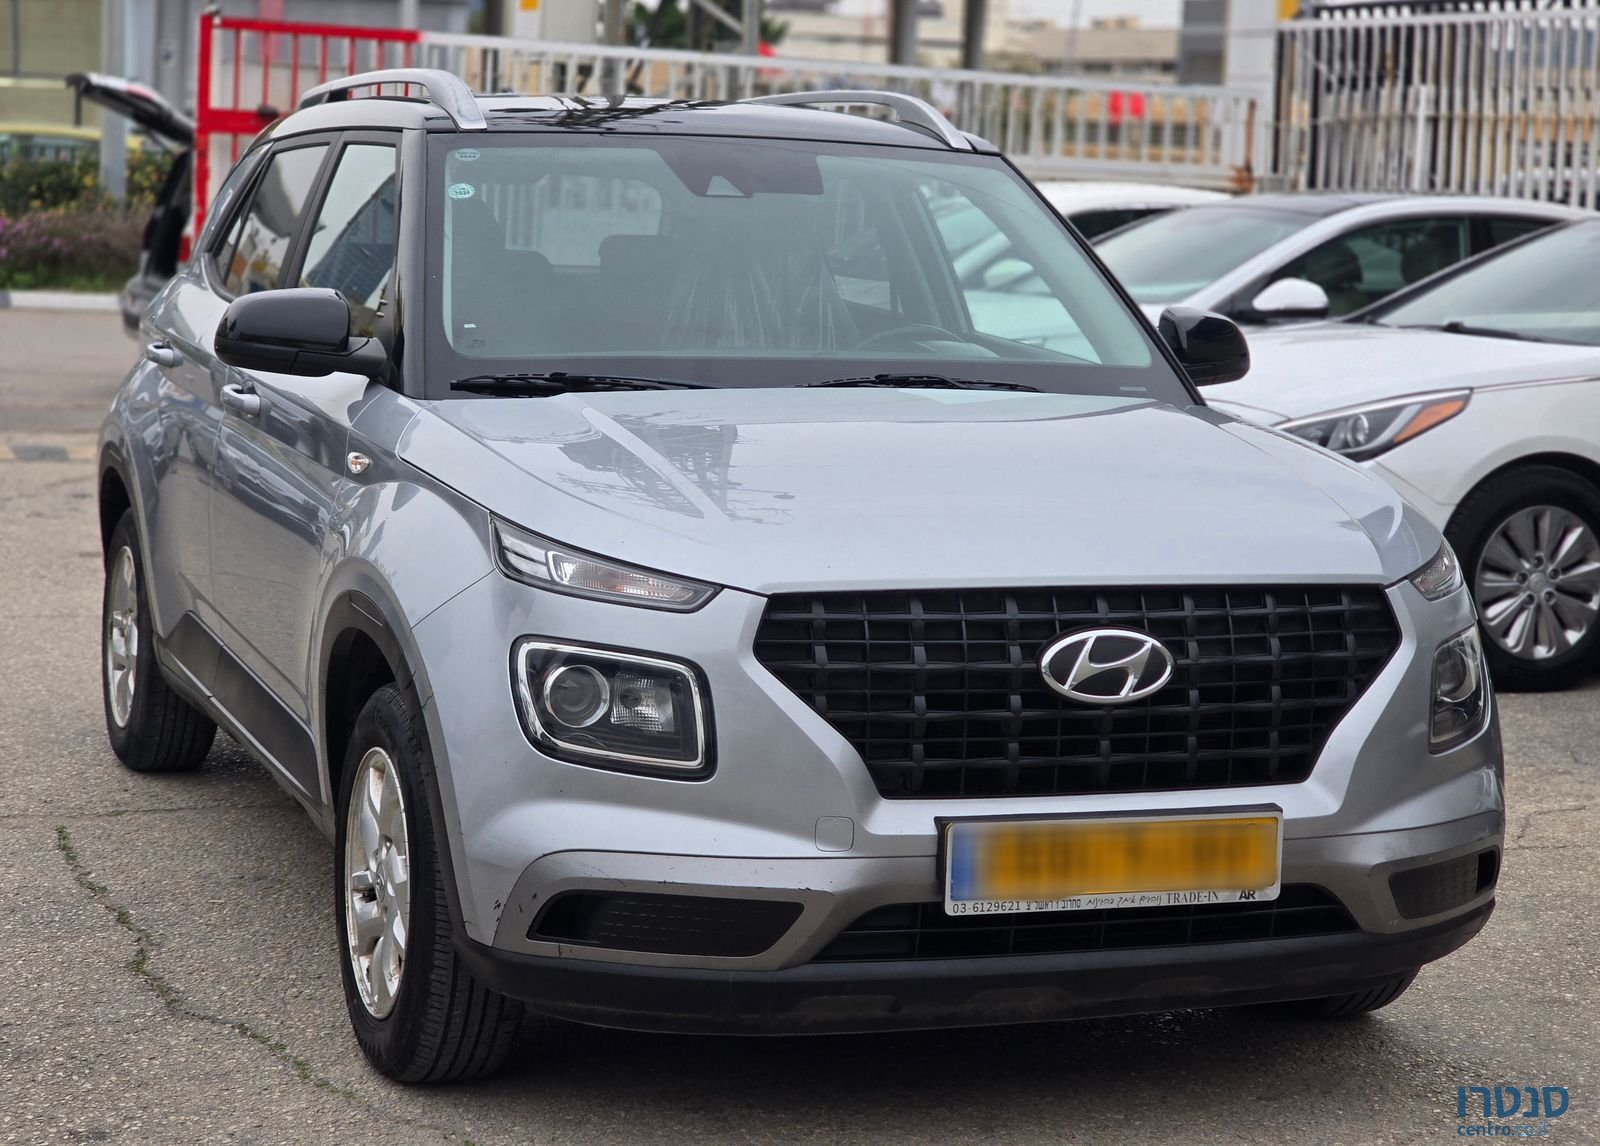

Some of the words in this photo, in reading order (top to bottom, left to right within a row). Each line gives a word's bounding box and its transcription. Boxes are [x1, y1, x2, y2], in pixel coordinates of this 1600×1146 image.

[1166, 890, 1219, 905] TRADE-IN
[1238, 889, 1256, 901] AR
[952, 901, 1021, 914] 03-6129621
